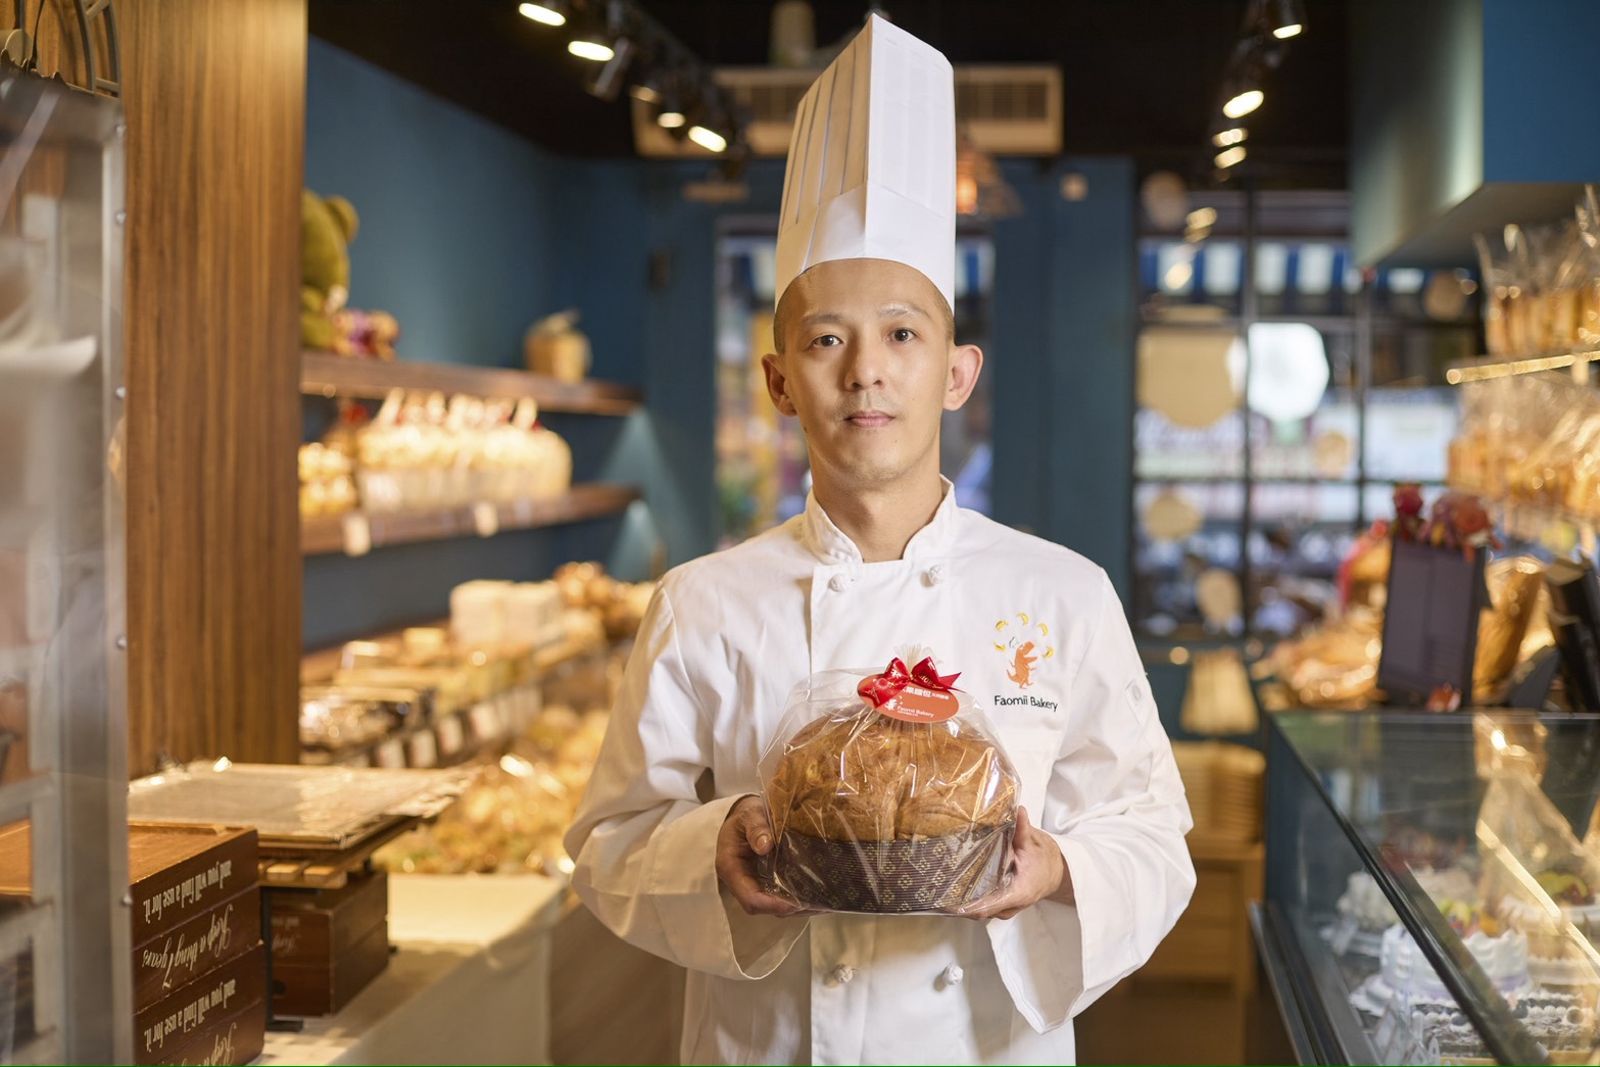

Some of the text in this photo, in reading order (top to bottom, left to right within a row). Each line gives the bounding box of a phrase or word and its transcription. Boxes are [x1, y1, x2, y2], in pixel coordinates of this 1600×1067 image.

[993, 695, 1058, 712] Faomii Bakery
[143, 860, 232, 924] and you will find a use for it.
[200, 935, 206, 953] a
[207, 904, 233, 957] Keep
[142, 937, 172, 968] years
[162, 953, 174, 990] 7
[174, 933, 198, 972] thing
[144, 979, 236, 1053] and you will find a use for it.
